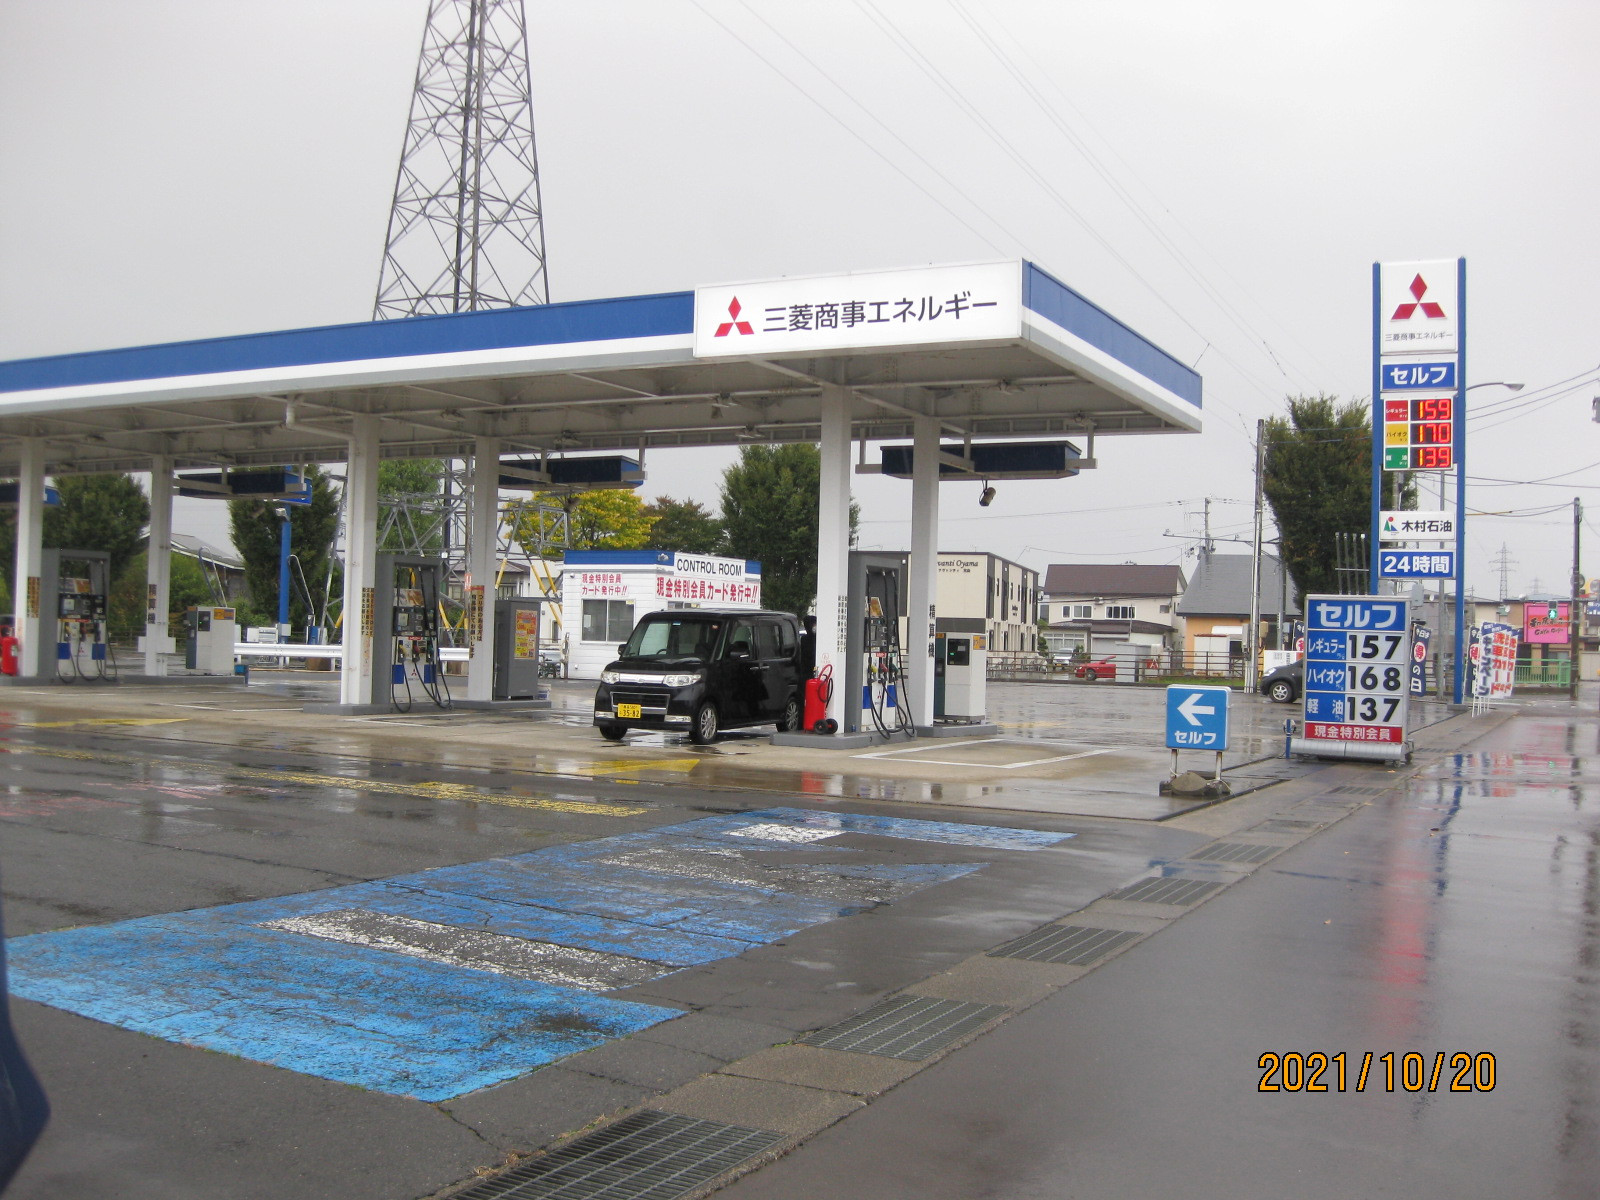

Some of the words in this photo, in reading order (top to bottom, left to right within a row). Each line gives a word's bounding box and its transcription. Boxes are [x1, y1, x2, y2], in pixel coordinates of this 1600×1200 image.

[763, 291, 997, 332] 三菱商事エネルギー
[1385, 331, 1453, 341] 三菱商事エネルギー
[1390, 367, 1447, 385] セルフ
[1419, 399, 1450, 420] 159
[1419, 423, 1450, 443] 170
[1419, 447, 1450, 467] 139
[1401, 520, 1452, 532] 木村石油
[676, 558, 717, 575] CONTROL
[718, 563, 742, 577] ROOM
[956, 559, 979, 569] Oyama
[1384, 556, 1449, 573] 24時間
[582, 573, 622, 584] 現金特別会員
[1316, 602, 1397, 628] セルフ
[928, 603, 936, 658] 精算機
[1308, 639, 1346, 653] レギュラー
[1349, 634, 1402, 660] 157
[1307, 668, 1345, 684] ハイオク
[1348, 666, 1401, 691] 168
[1347, 696, 1401, 722] 137
[1174, 730, 1217, 745] セルフ
[1314, 725, 1390, 740] 現金特別会員
